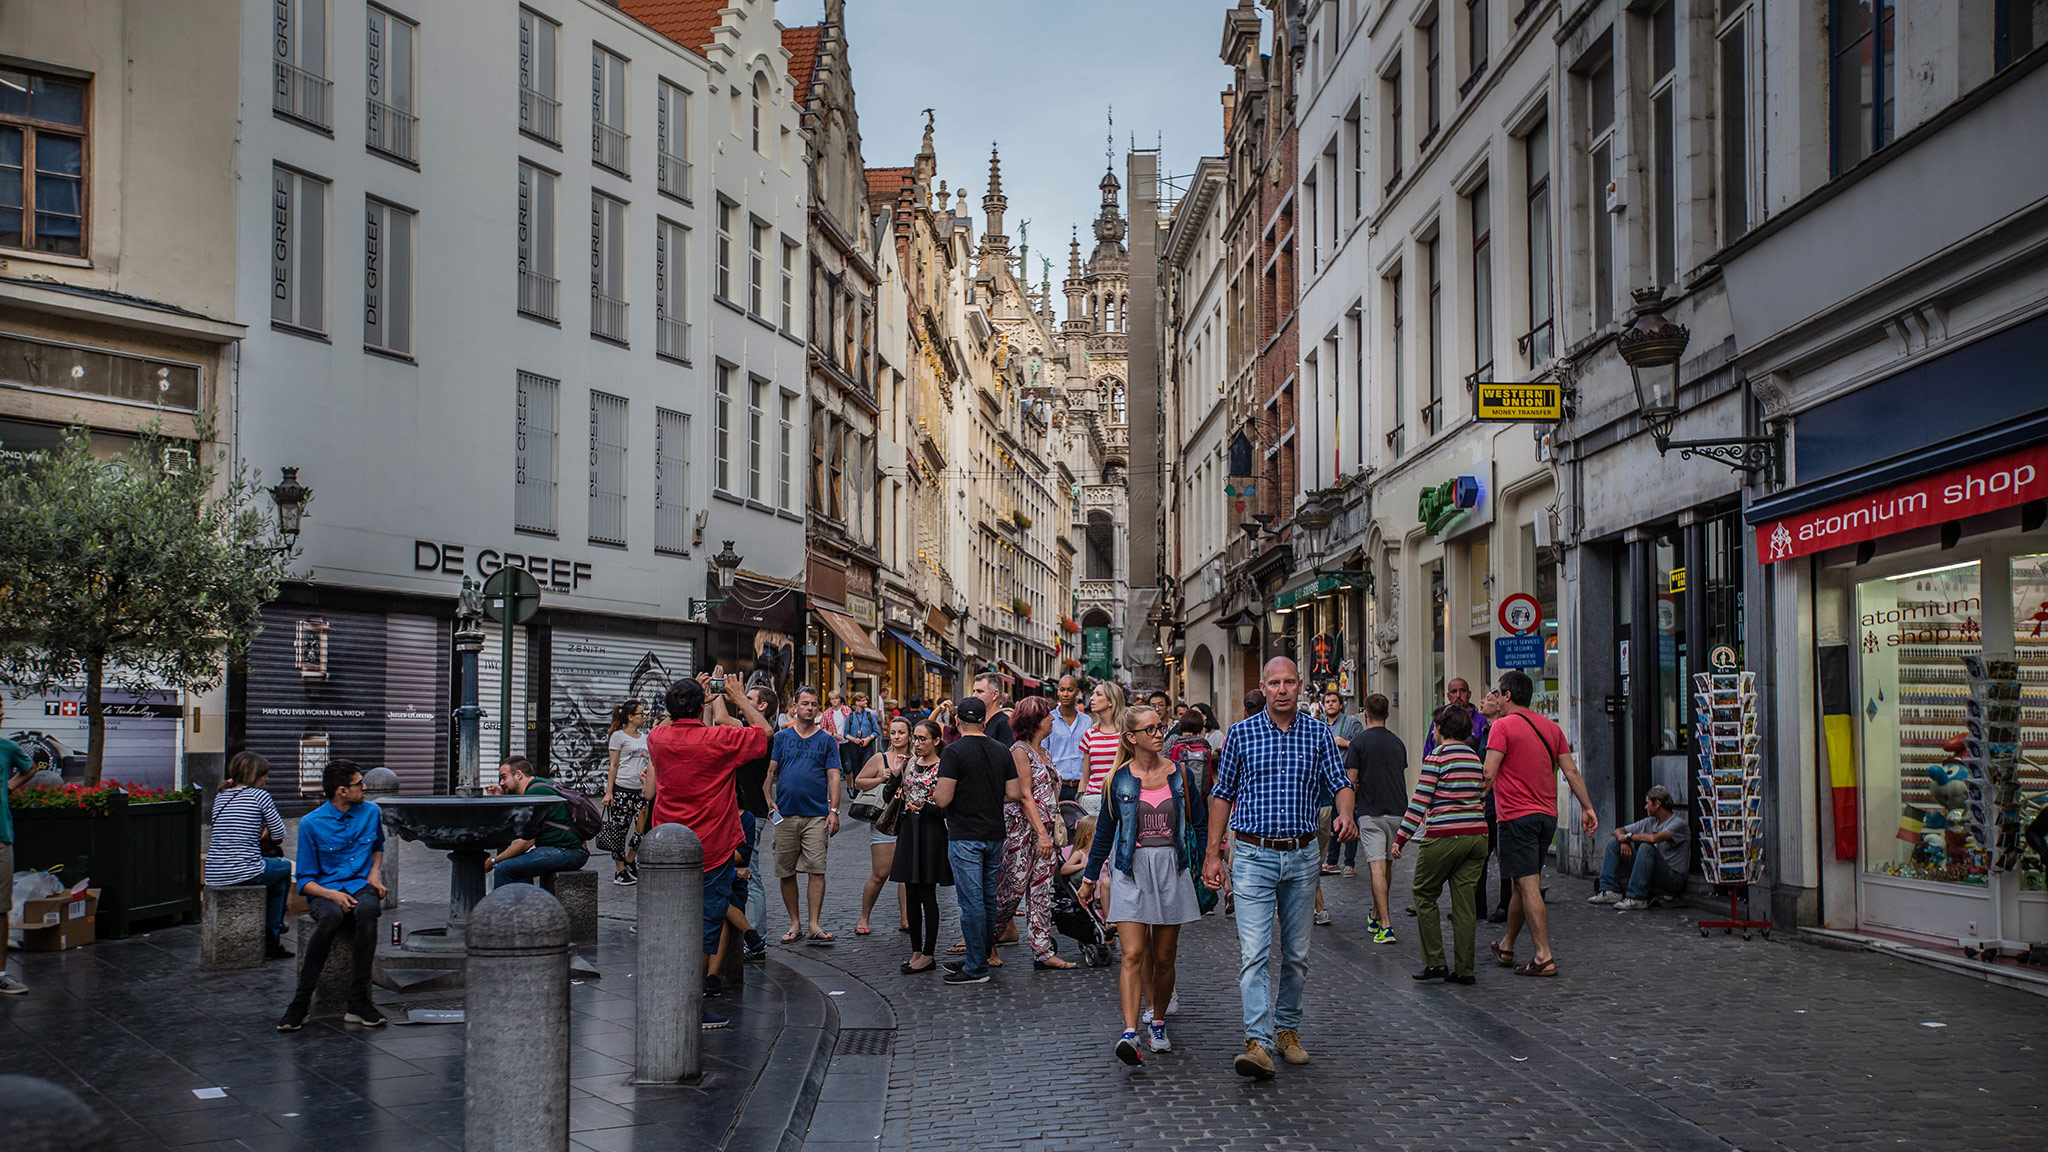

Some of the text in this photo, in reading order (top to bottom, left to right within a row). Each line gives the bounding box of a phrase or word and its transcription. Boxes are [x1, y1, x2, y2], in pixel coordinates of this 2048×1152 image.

[277, 62, 288, 96] DE
[368, 17, 380, 132] DE GREEF
[520, 17, 529, 121] DE GREEF
[592, 54, 601, 121] GREEF
[657, 89, 666, 151] GREEF
[275, 178, 288, 300] DE GREEF
[518, 172, 528, 275] DE GREEF
[366, 211, 378, 325] DE GREEF
[591, 201, 601, 300] DE GREEF
[656, 227, 666, 321] DE GREEF
[1484, 389, 1543, 399] WESTERN
[1502, 398, 1543, 407] UNION
[1798, 464, 2036, 542] atomium shop
[414, 539, 592, 590] DE GREEF
[1861, 597, 1980, 627] atomium
[1886, 628, 1950, 646] shop
[484, 659, 500, 670] IWC
[568, 644, 606, 654] ZENITH
[114, 703, 160, 721] Technology
[262, 707, 278, 715] HAVE
[292, 708, 305, 716] EVER
[330, 709, 343, 717] REAL
[1144, 813, 1168, 828] FOLLOW
